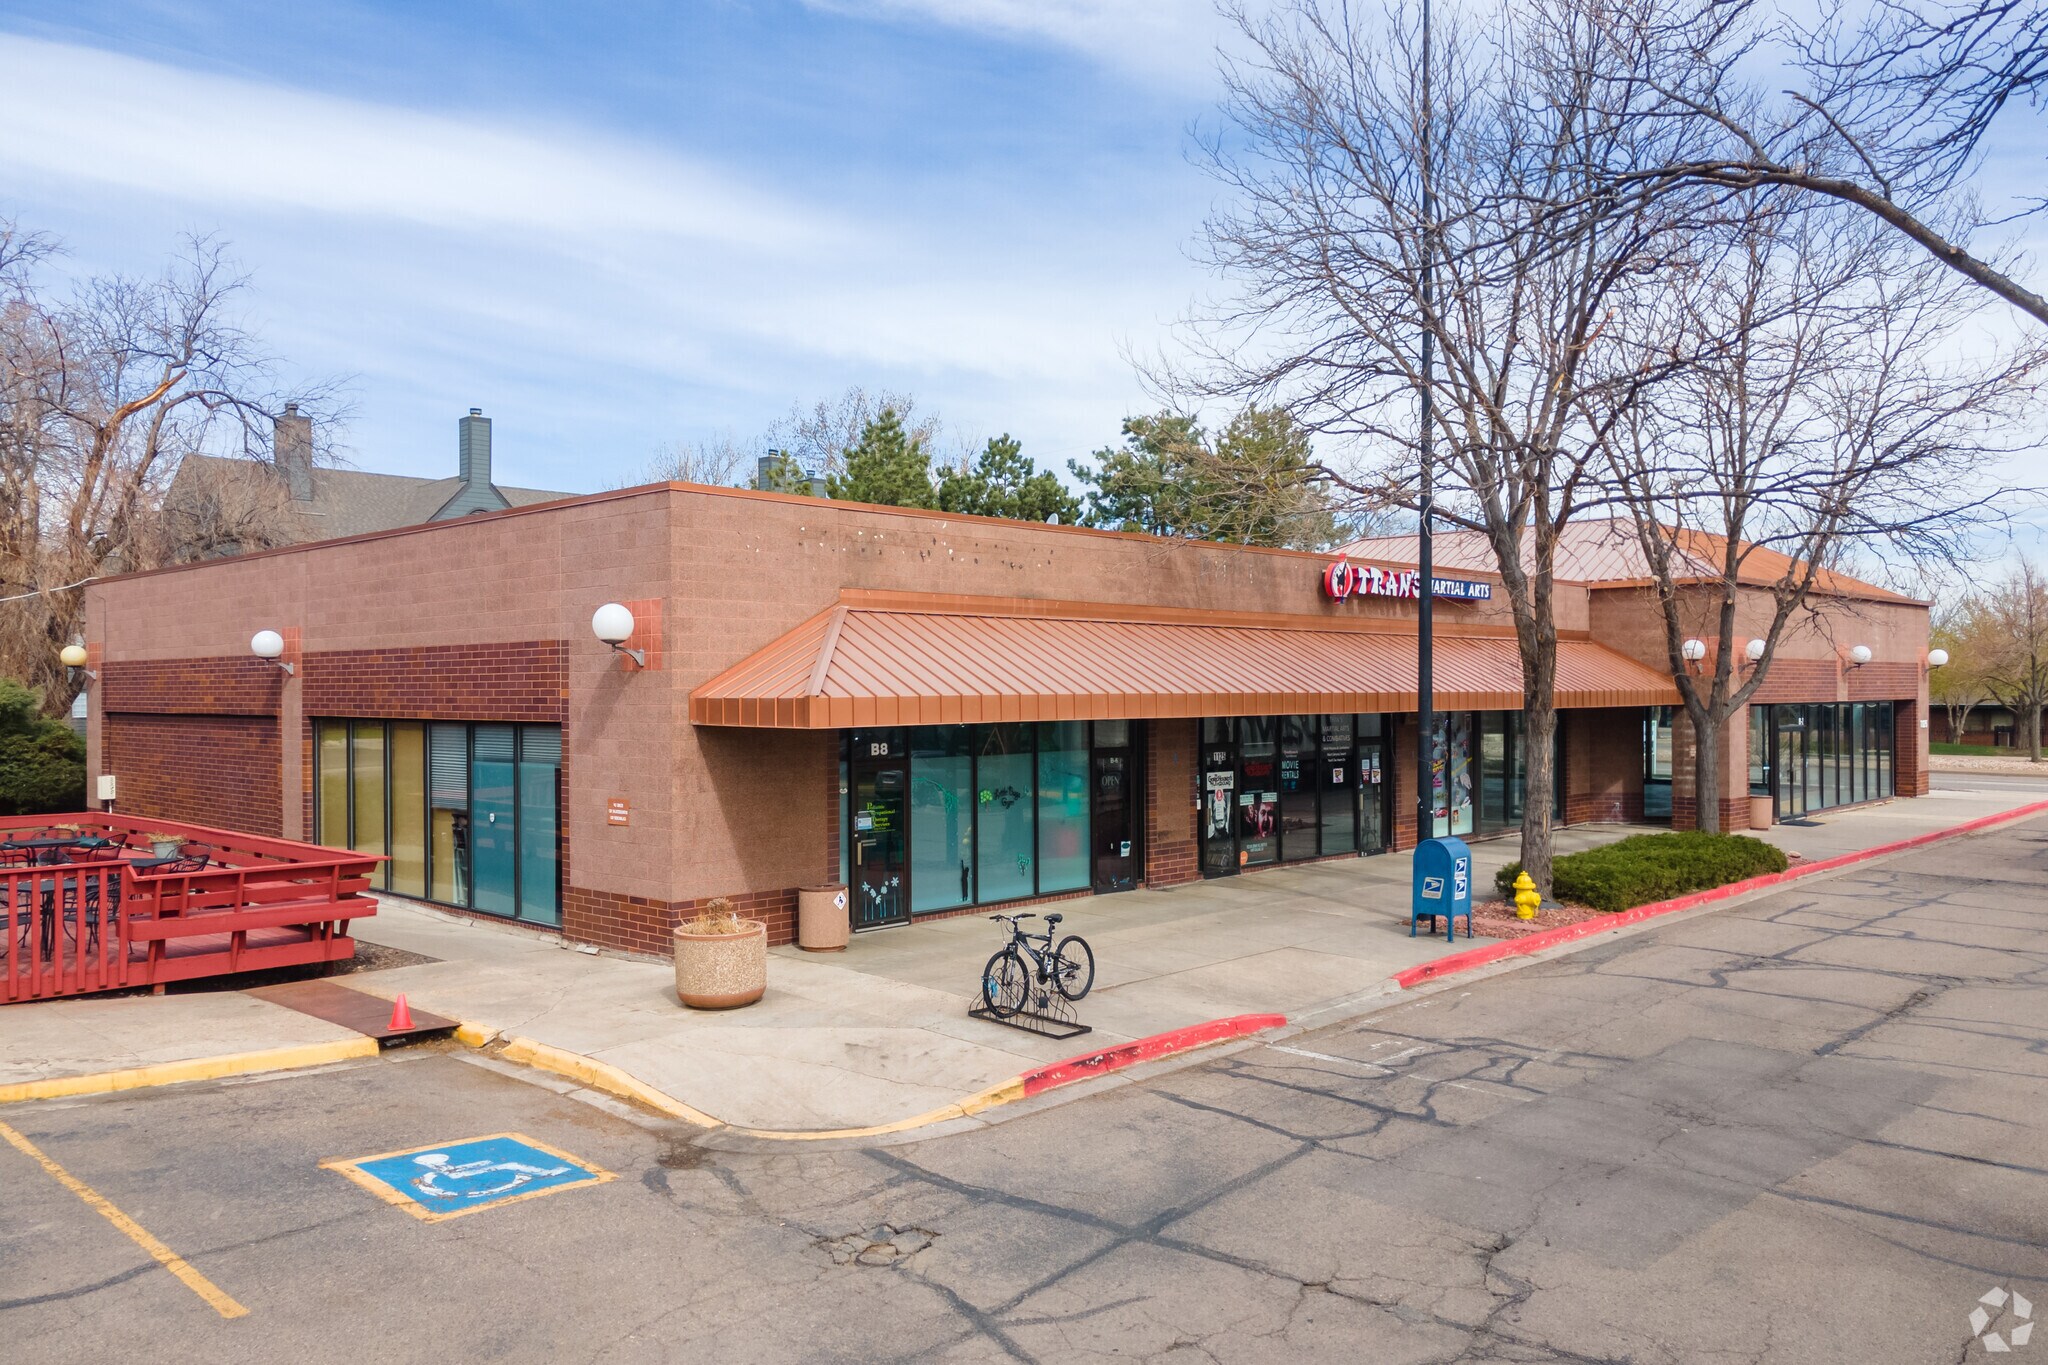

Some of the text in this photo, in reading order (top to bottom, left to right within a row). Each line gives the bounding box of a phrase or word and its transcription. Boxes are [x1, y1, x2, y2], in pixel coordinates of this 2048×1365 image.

[1431, 579, 1490, 598] ARTIAL ARTS
[871, 743, 888, 756] B8
[1281, 761, 1299, 770] MOVIE
[1281, 770, 1299, 779] RENTALS
[1101, 775, 1120, 786] OPEN
